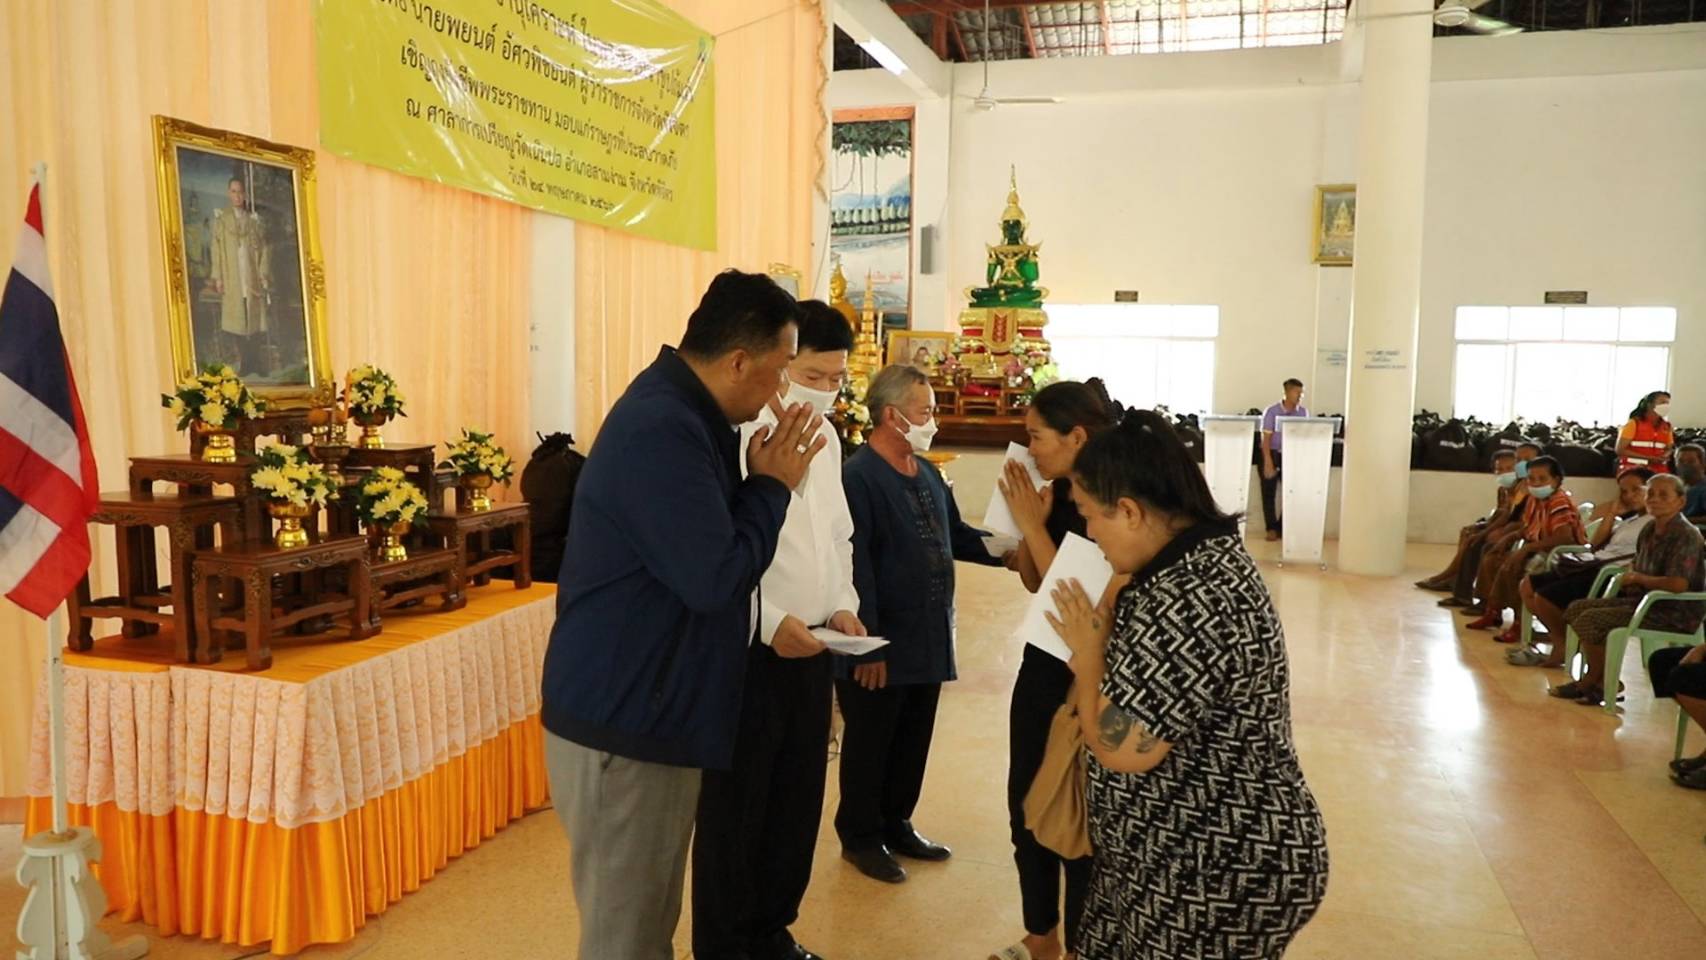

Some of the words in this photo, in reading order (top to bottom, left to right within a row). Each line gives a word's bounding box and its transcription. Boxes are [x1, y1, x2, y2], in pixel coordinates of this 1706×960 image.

[410, 0, 498, 54] นายพยนต์
[405, 98, 421, 119] ณ
